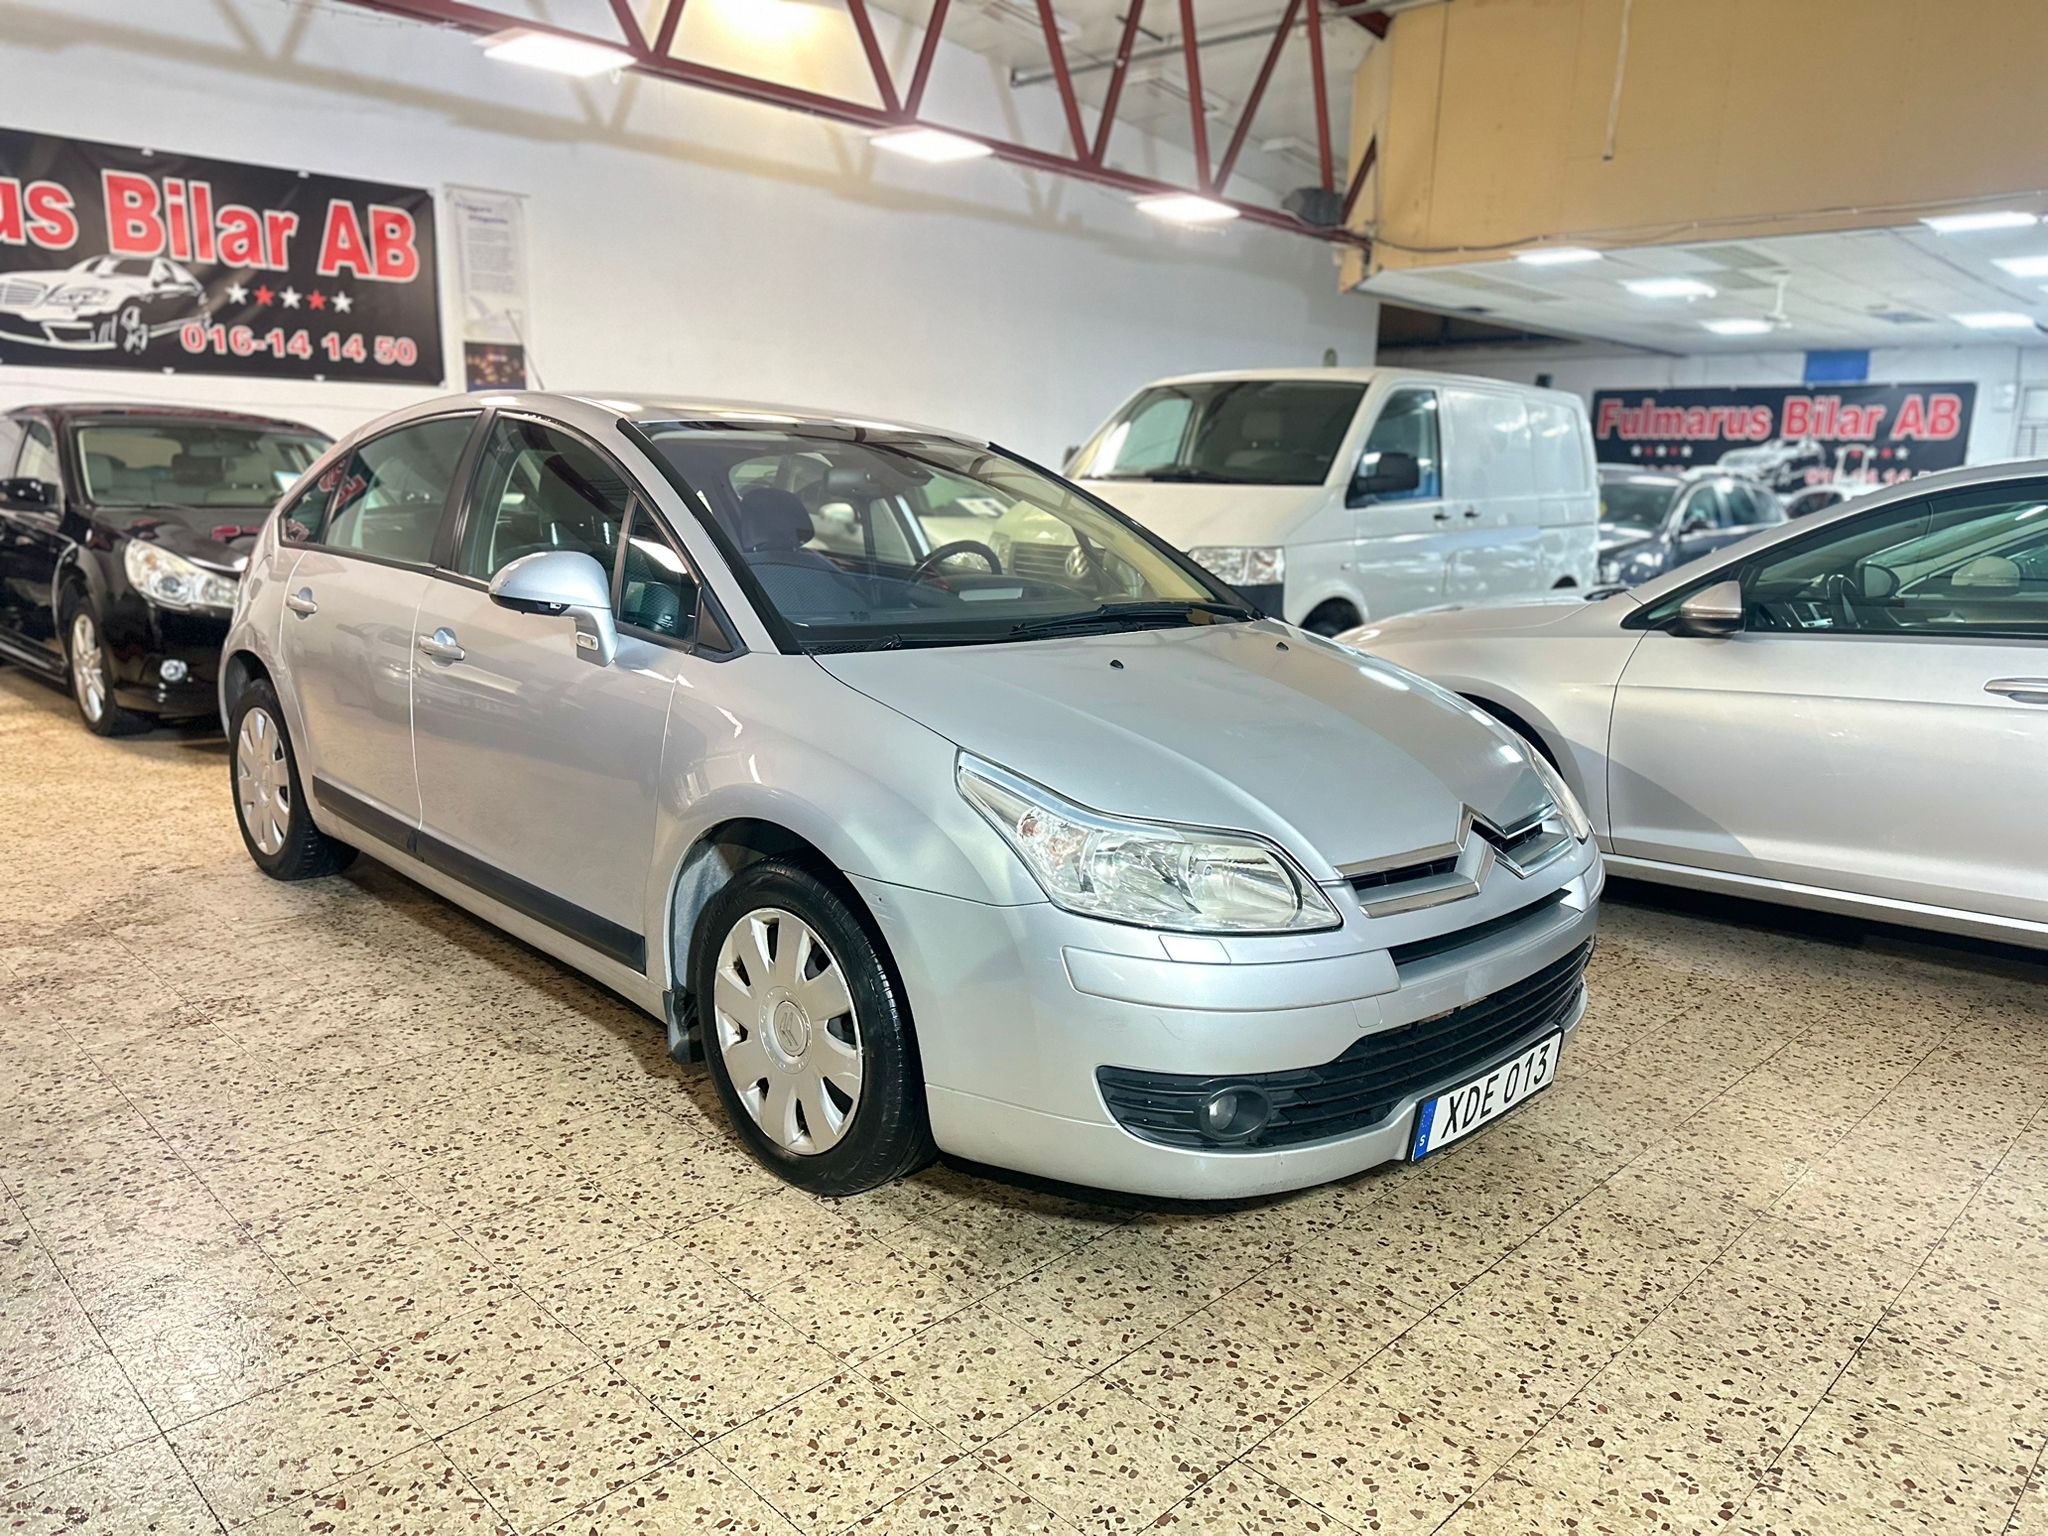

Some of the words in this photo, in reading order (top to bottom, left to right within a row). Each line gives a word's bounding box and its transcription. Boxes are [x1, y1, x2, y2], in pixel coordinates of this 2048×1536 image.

[101, 168, 299, 271] Bilar
[316, 199, 420, 282] AB
[180, 323, 313, 360] 016-14
[321, 331, 367, 363] 14
[373, 335, 418, 366] 50
[1597, 398, 1773, 440] Fulmarus
[1780, 395, 1886, 440] Bilar
[1888, 393, 1962, 440] AB
[1441, 1073, 1499, 1139] XDE
[1504, 1043, 1550, 1104] 013
[1419, 1134, 1426, 1147] S
